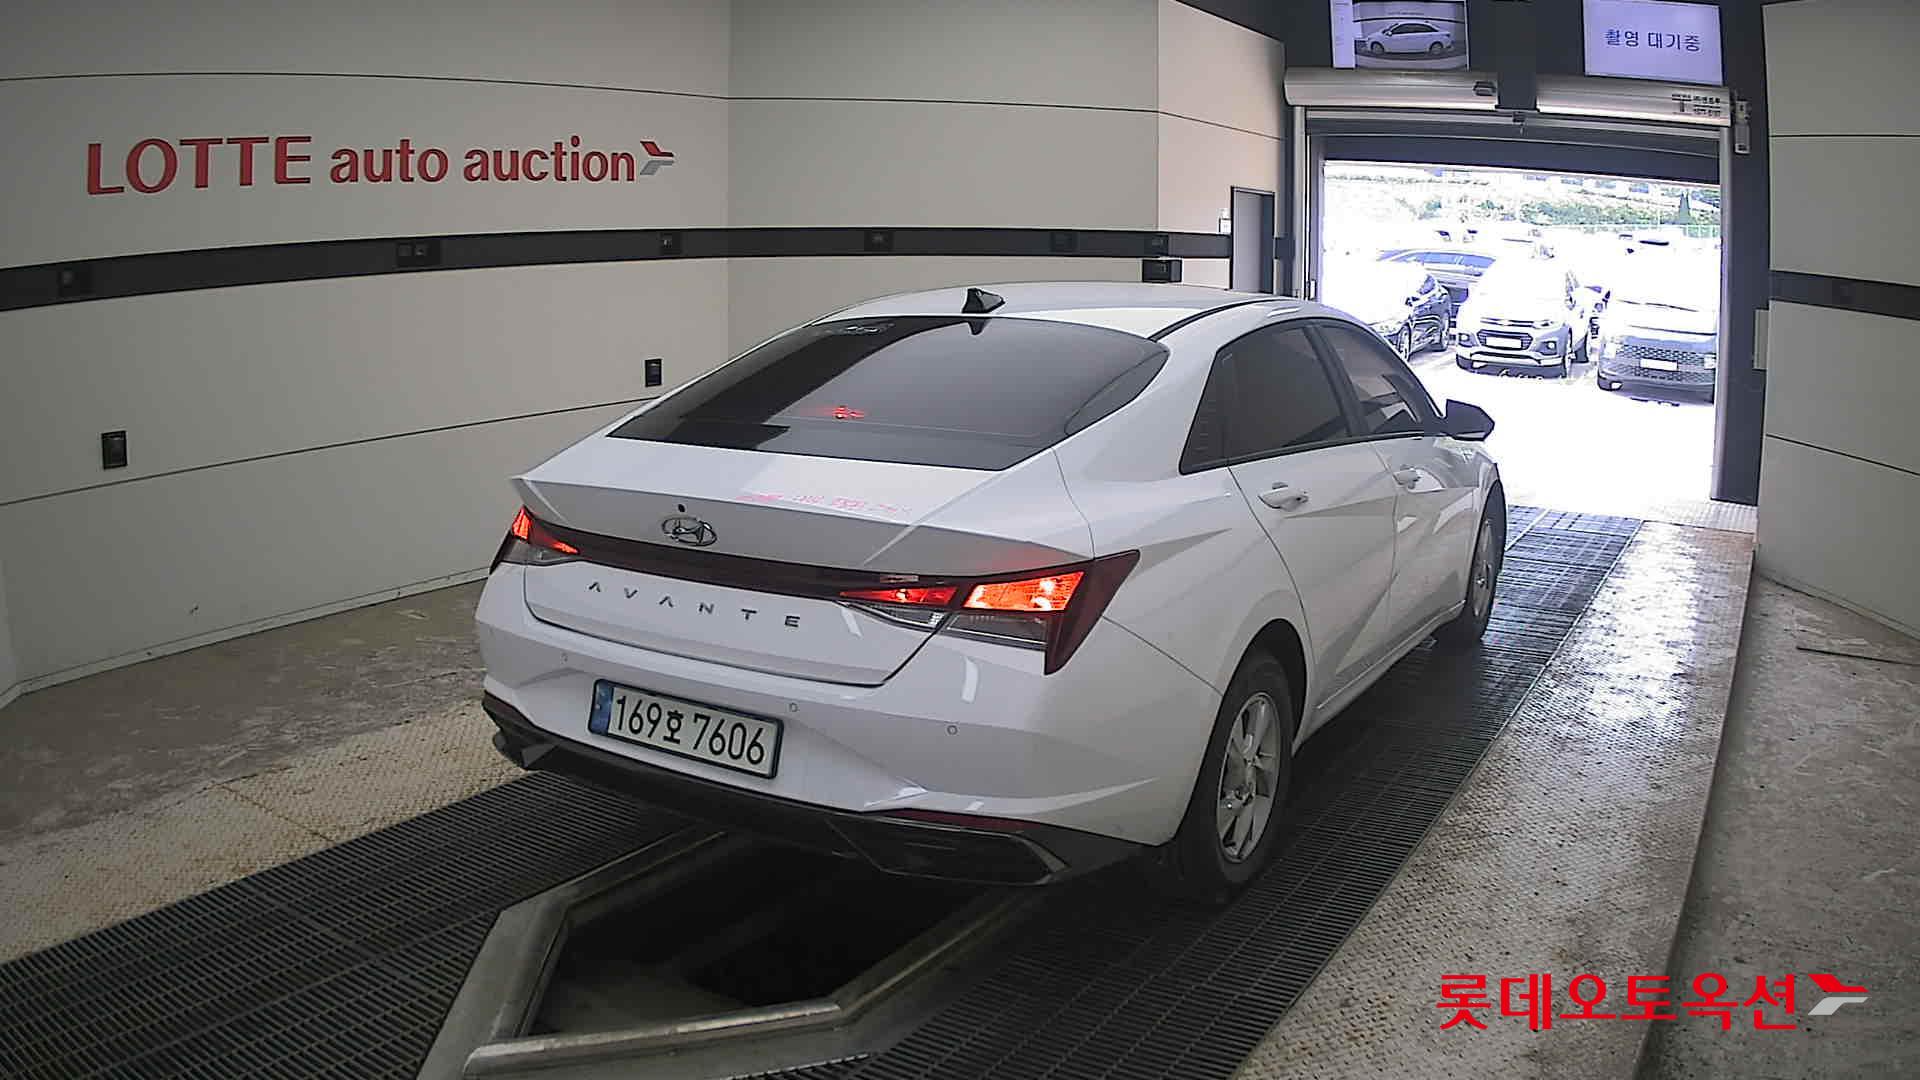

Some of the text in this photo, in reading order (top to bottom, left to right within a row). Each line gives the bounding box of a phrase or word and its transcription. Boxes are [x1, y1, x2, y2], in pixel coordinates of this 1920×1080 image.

[1604, 29, 1701, 52] 촬영 대기중
[86, 135, 636, 195] LOTTE auto auction
[587, 581, 801, 628] AVANTE
